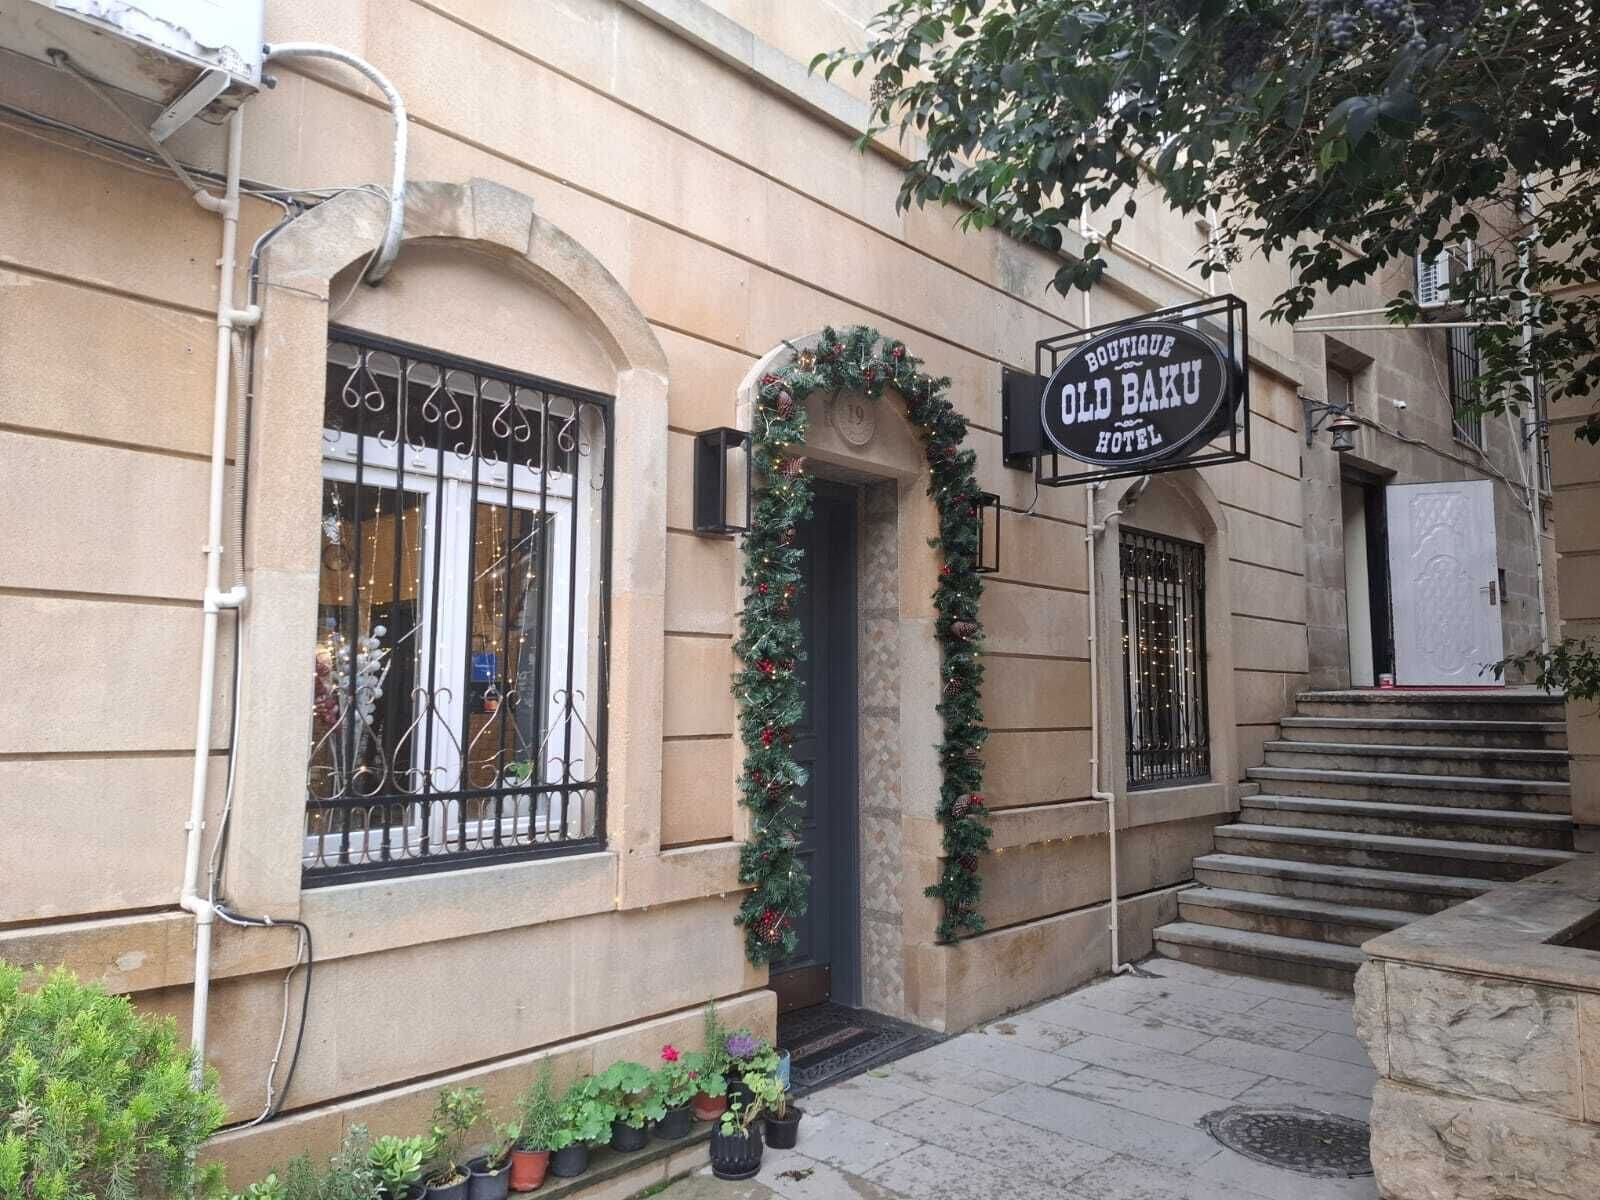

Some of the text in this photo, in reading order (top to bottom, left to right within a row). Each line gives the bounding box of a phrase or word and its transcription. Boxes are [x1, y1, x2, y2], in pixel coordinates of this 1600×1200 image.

[1085, 334, 1176, 373] BOUTIQUE
[1061, 359, 1202, 425] OLD BAKU
[1095, 424, 1163, 454] HOTEL
